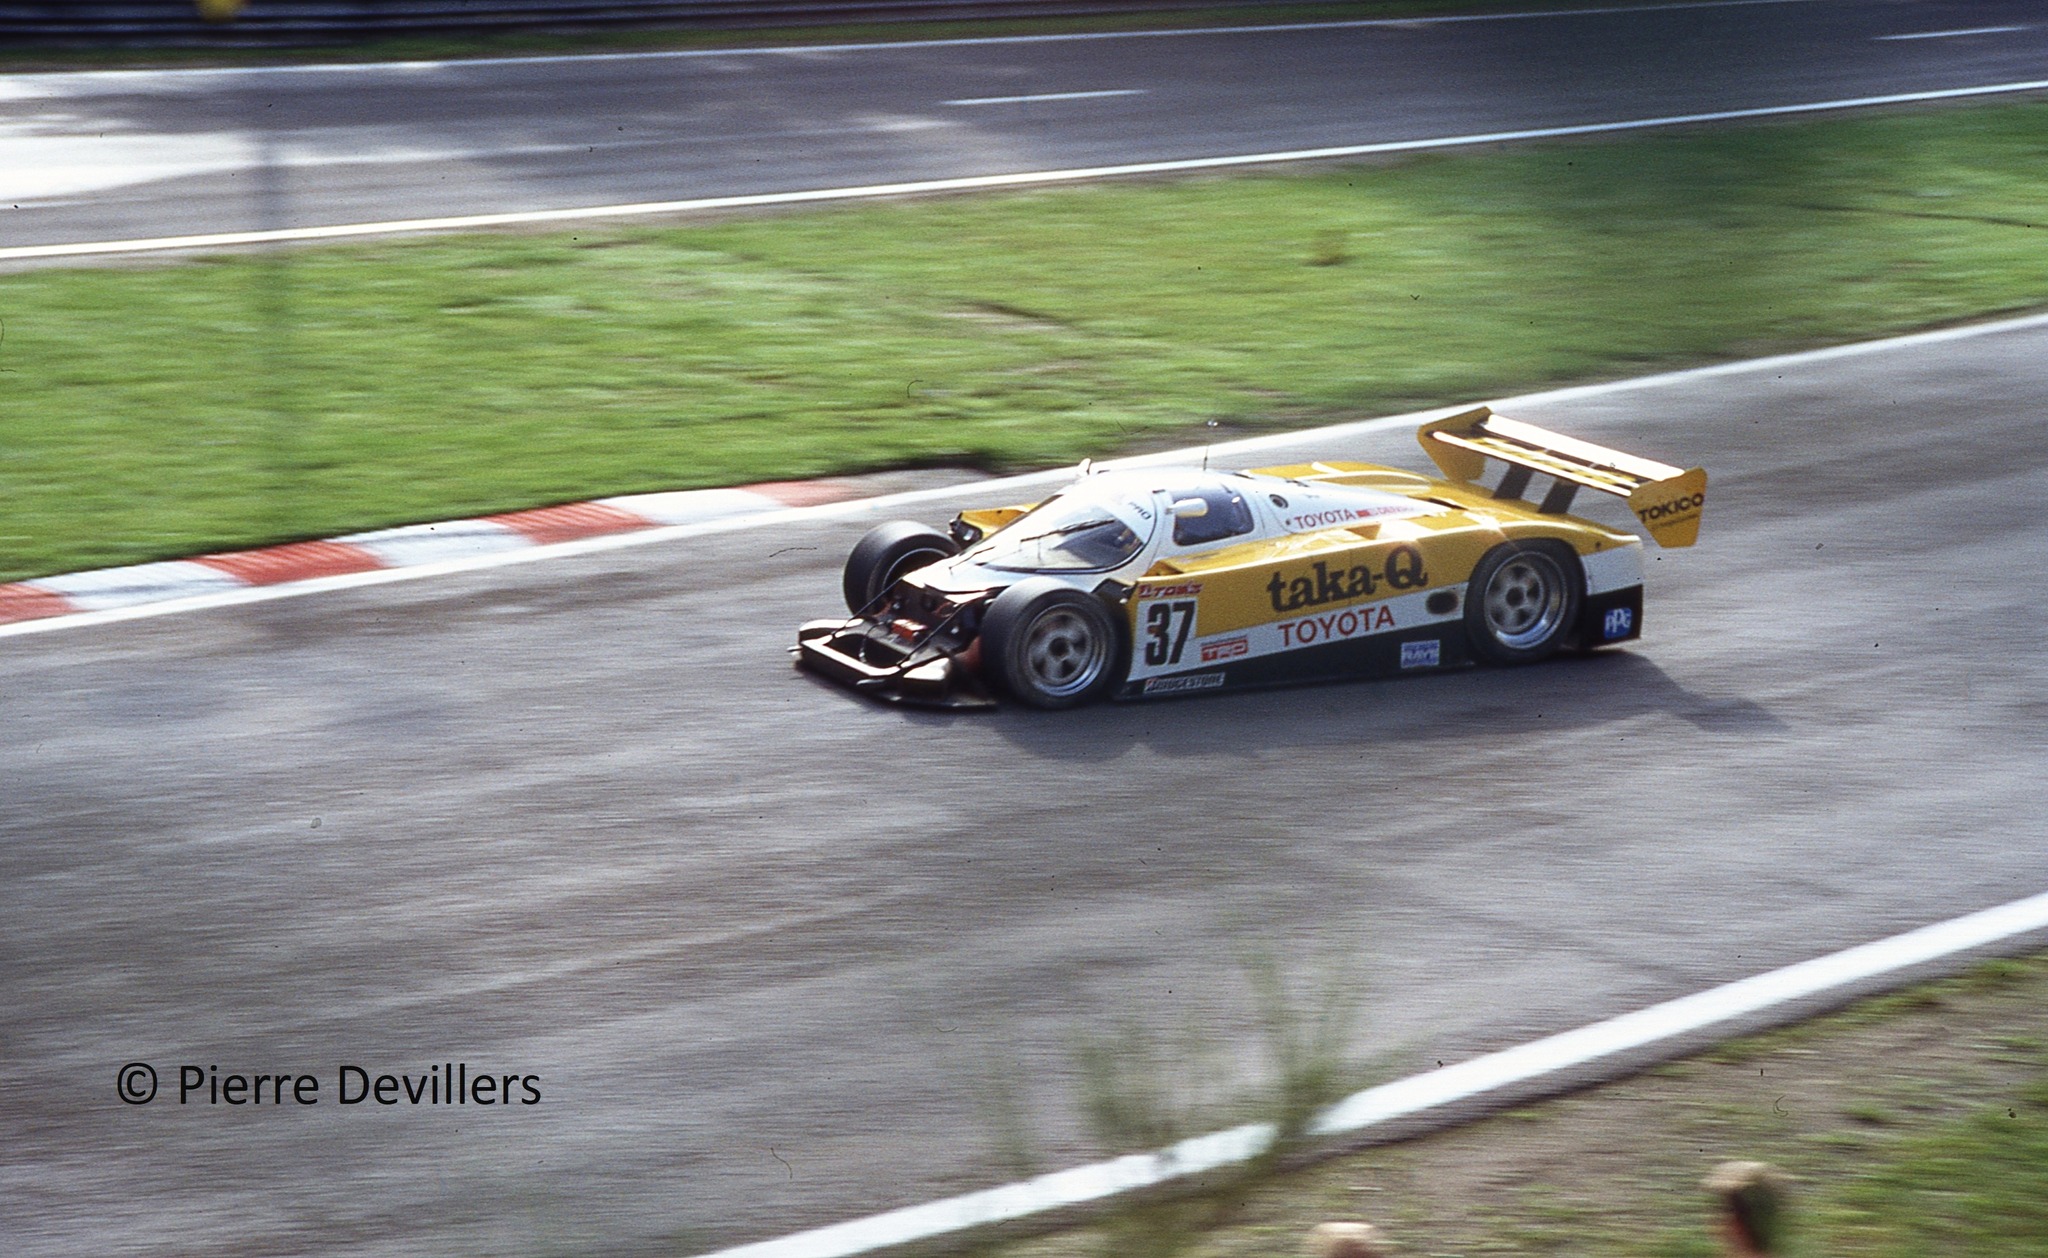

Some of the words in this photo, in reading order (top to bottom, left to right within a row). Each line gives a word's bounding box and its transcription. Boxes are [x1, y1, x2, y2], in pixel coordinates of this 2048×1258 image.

[1294, 508, 1356, 530] TOYOTA
[1638, 492, 1705, 523] TOKICO
[1266, 544, 1429, 613] taka-Q
[1145, 600, 1196, 667] 37
[1277, 604, 1396, 648] TOYOTA
[1604, 607, 1633, 634] PPG
